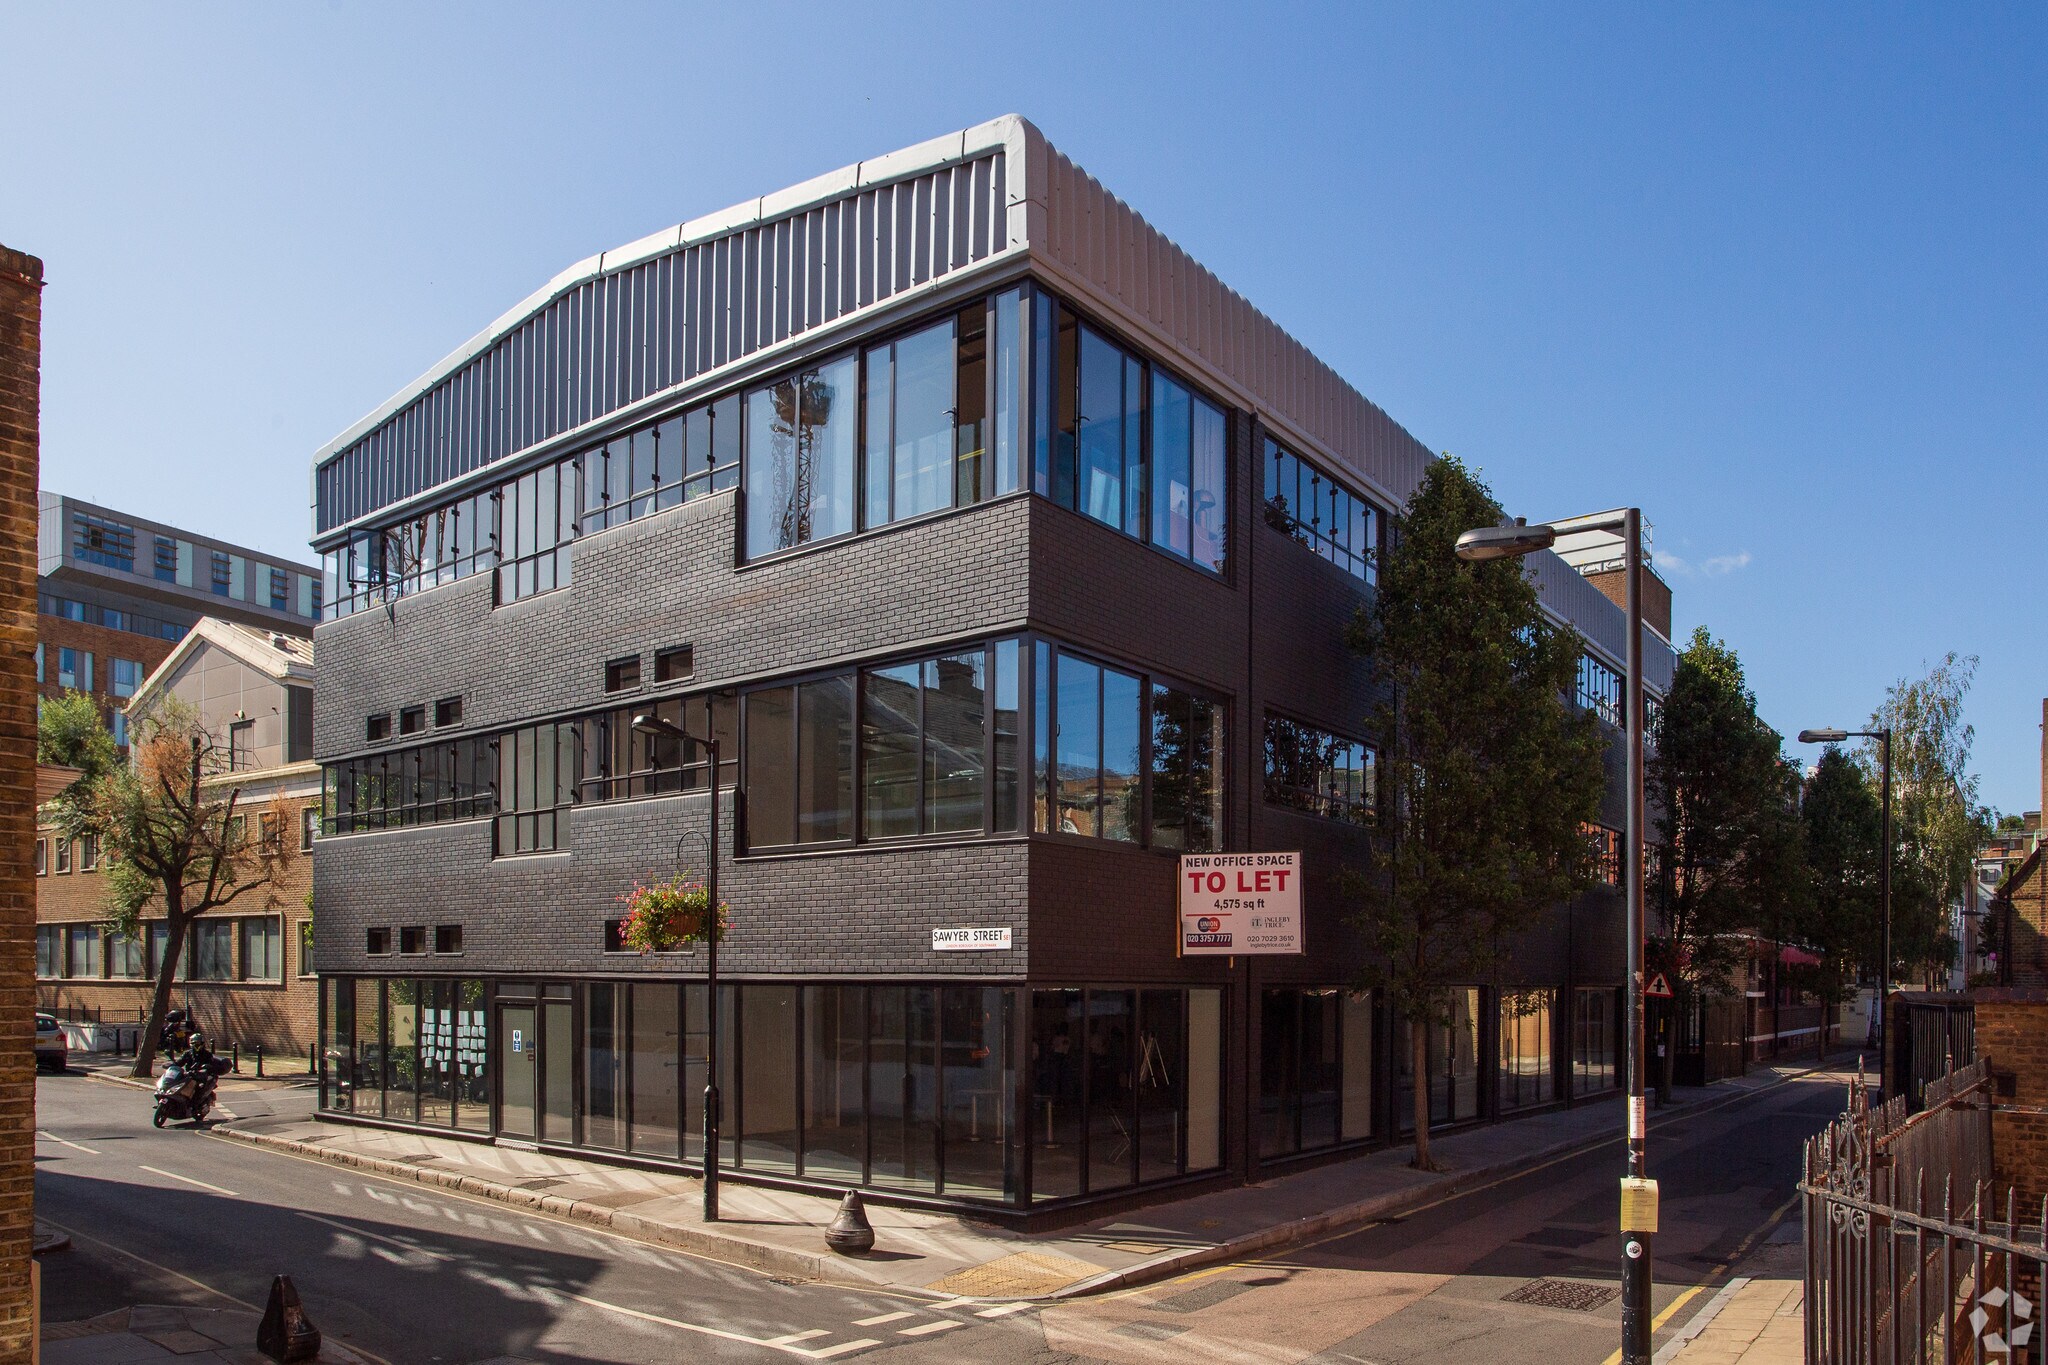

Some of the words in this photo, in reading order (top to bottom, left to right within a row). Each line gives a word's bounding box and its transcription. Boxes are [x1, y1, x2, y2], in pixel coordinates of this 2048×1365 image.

[1186, 858, 1210, 867] NEW
[1213, 856, 1253, 867] OFFICE
[1257, 855, 1292, 865] SPACE
[1188, 871, 1226, 893] TO
[1237, 870, 1290, 892] LET
[1214, 899, 1240, 910] 4,575
[1243, 900, 1254, 910] sq
[1257, 898, 1265, 908] ft
[934, 931, 969, 942] SAWYER
[973, 930, 1003, 941] STREET
[1216, 934, 1231, 942] 7777
